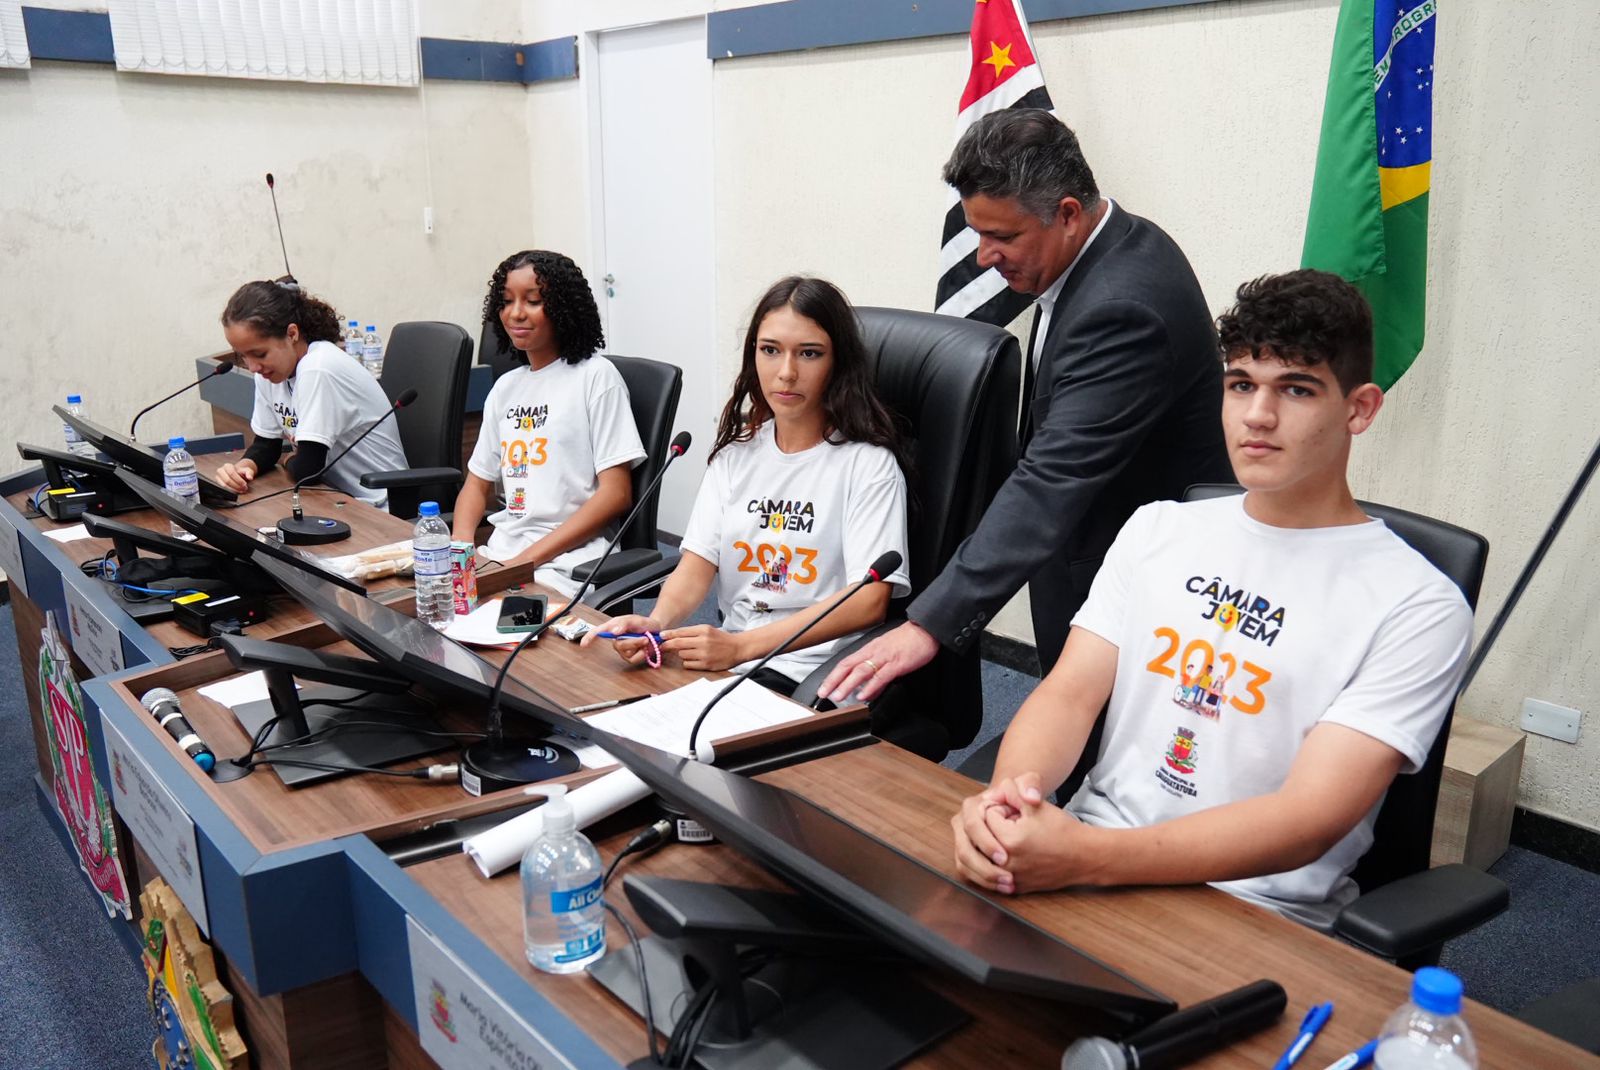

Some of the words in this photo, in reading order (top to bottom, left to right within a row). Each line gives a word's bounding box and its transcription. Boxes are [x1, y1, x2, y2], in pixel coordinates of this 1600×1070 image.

[500, 437, 548, 467] 03
[746, 496, 815, 518] CÂMARA
[759, 514, 815, 534] JOVEM
[1185, 576, 1286, 628] CÂMARA
[1201, 601, 1281, 648] JOVEM
[1145, 626, 1273, 715] 2023
